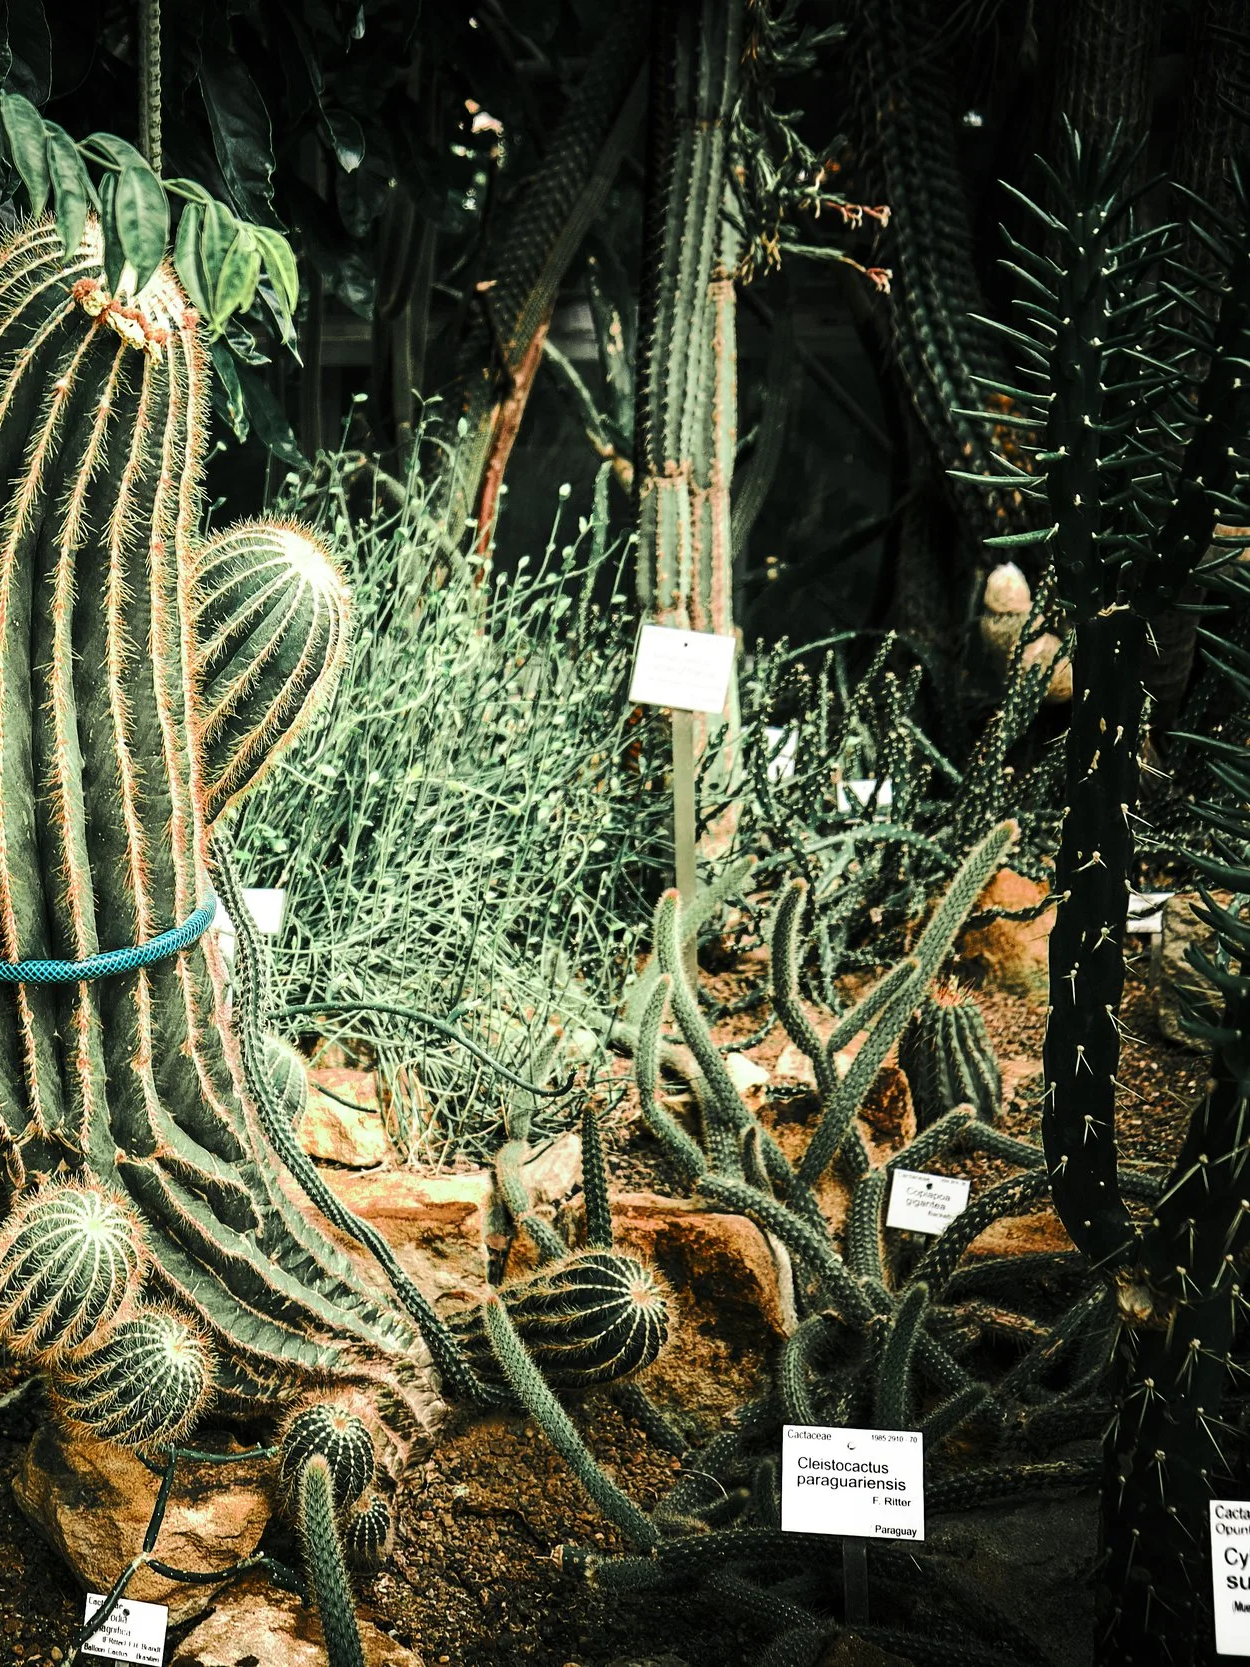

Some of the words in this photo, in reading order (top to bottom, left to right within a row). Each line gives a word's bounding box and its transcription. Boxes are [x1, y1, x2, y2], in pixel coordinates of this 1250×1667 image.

[787, 1429, 832, 1440] Cactaceae
[797, 1456, 889, 1474] Cleistocactus
[797, 1474, 907, 1491] paraguariensis
[872, 1496, 881, 1505] F.
[884, 1497, 911, 1507] Ritter
[875, 1524, 917, 1538] Paraguay
[1215, 1523, 1250, 1536] Opun
